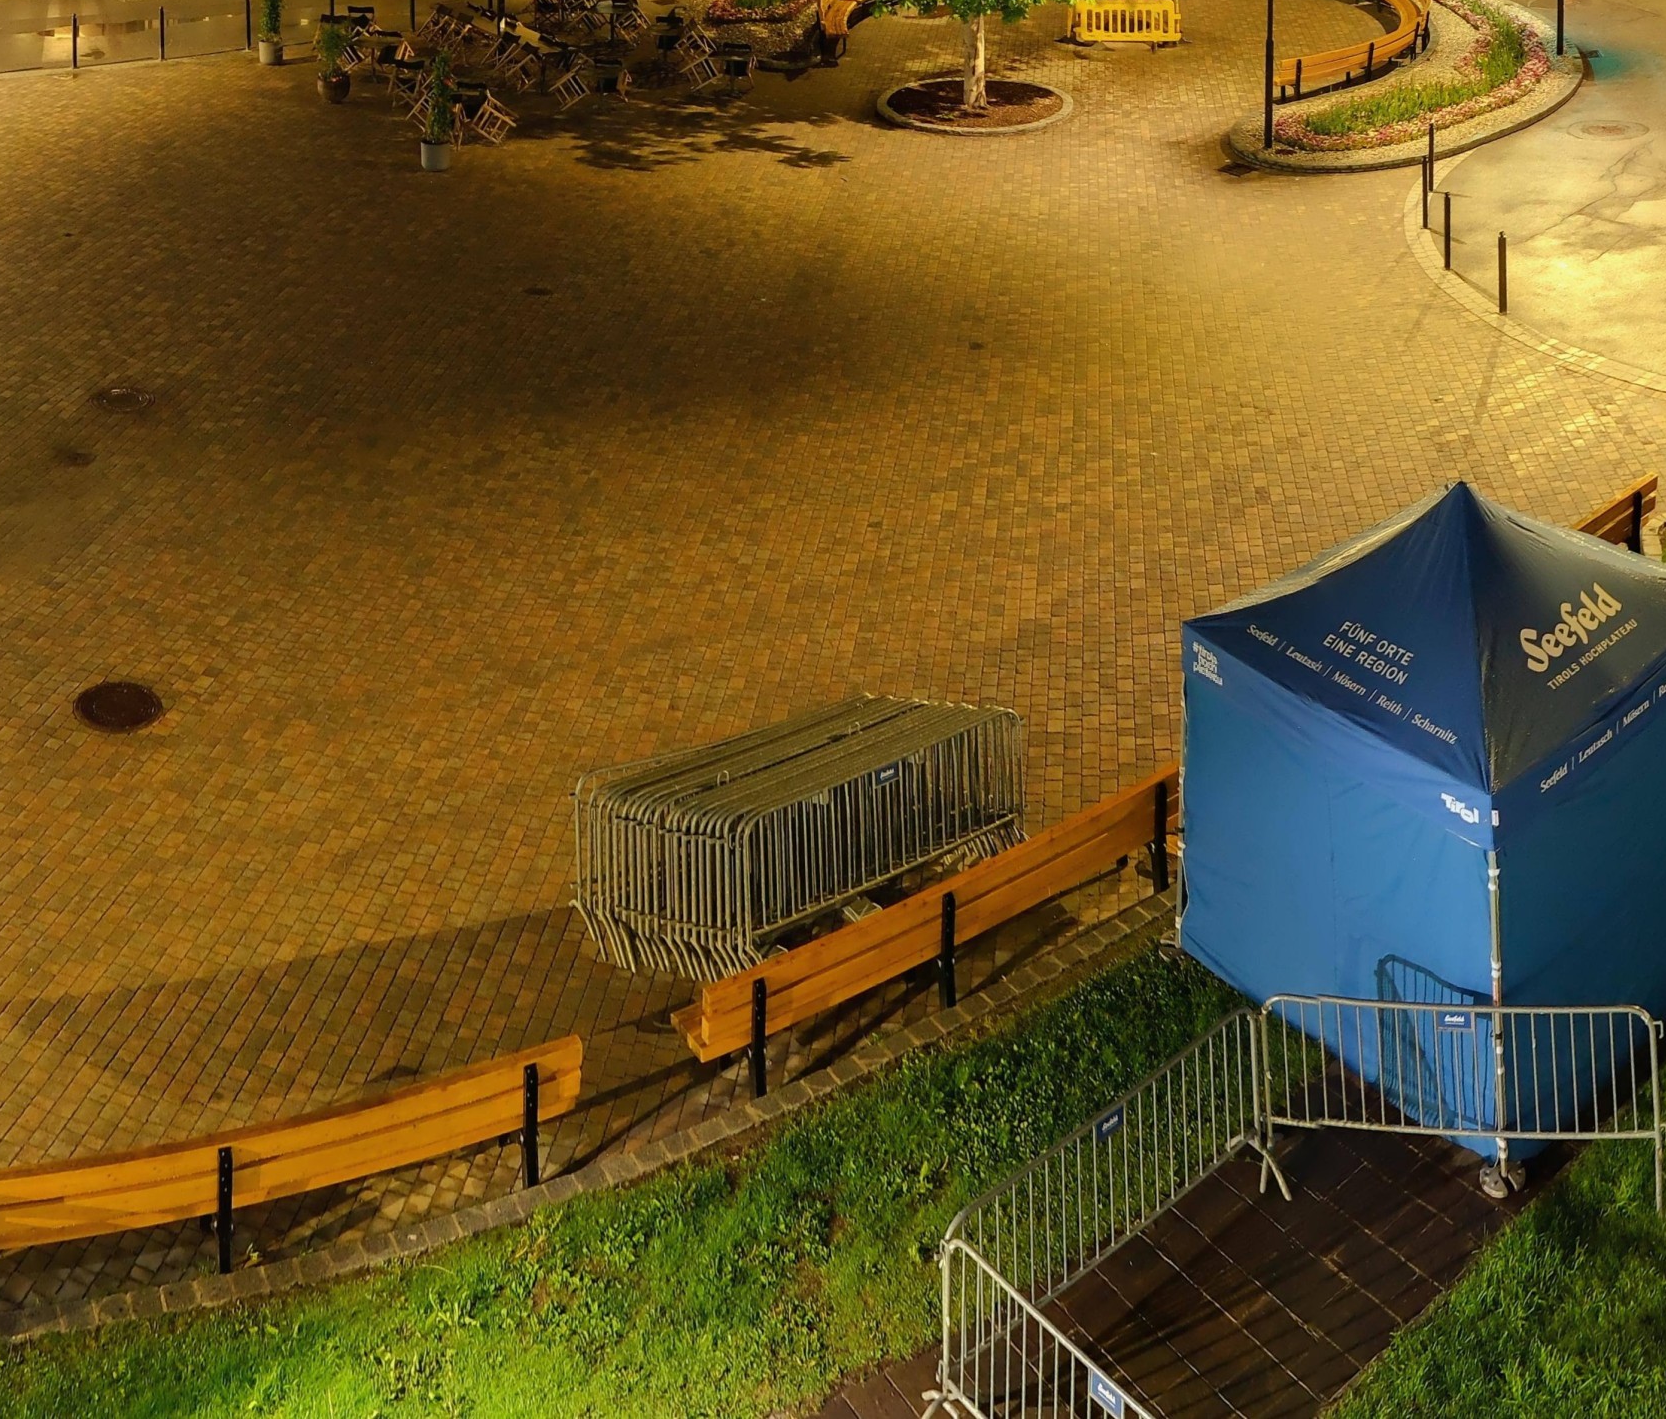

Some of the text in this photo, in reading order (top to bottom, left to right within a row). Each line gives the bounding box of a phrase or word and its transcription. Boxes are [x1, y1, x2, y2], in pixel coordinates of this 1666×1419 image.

[1323, 634, 1409, 685] EINE REGION
[1339, 621, 1414, 666] FÜNF ORTE
[1520, 582, 1622, 672] Seefeld
[1547, 619, 1638, 690] TIROLS HOCHPLATEAU
[1247, 624, 1279, 647] Seefeld
[1332, 670, 1367, 696] Mösern
[1375, 694, 1403, 716] Reith
[1411, 713, 1458, 745] Scharnitz
[1540, 763, 1568, 793] Seefeld
[1578, 728, 1613, 763] Leutasch
[1440, 792, 1480, 824] Tirol
